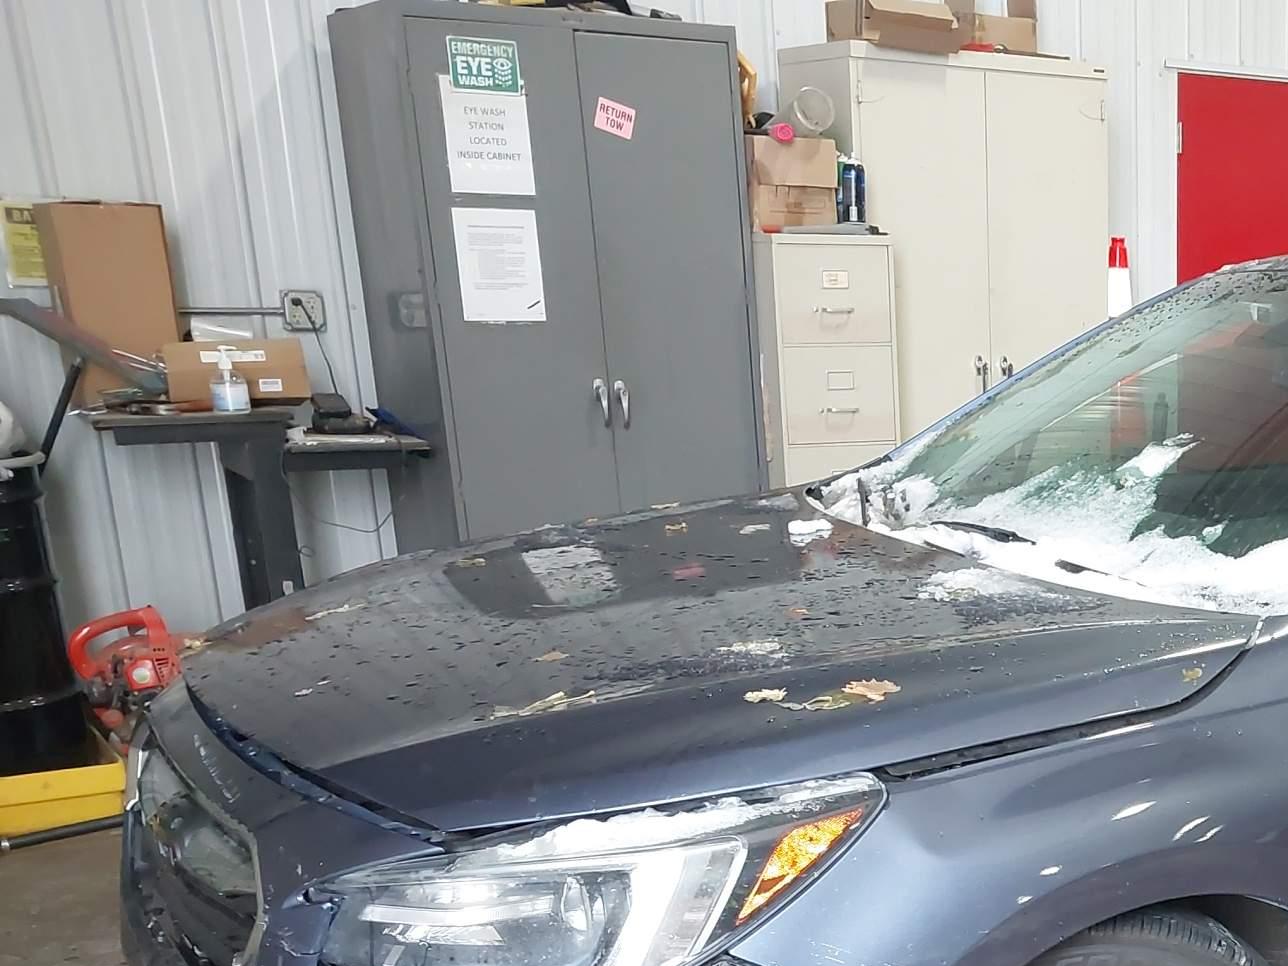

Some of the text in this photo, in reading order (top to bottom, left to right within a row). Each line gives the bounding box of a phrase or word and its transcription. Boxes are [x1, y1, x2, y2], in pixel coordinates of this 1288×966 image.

[451, 41, 513, 58] EMERGENCY
[455, 56, 493, 76] EYE
[457, 75, 494, 87] WASH
[463, 106, 506, 117] EYE WASH
[600, 103, 632, 123] RETURN
[468, 121, 505, 131] STATION
[606, 116, 625, 132] TOW
[469, 136, 507, 146] LOCATED
[456, 151, 522, 161] INSIDE CABINET
